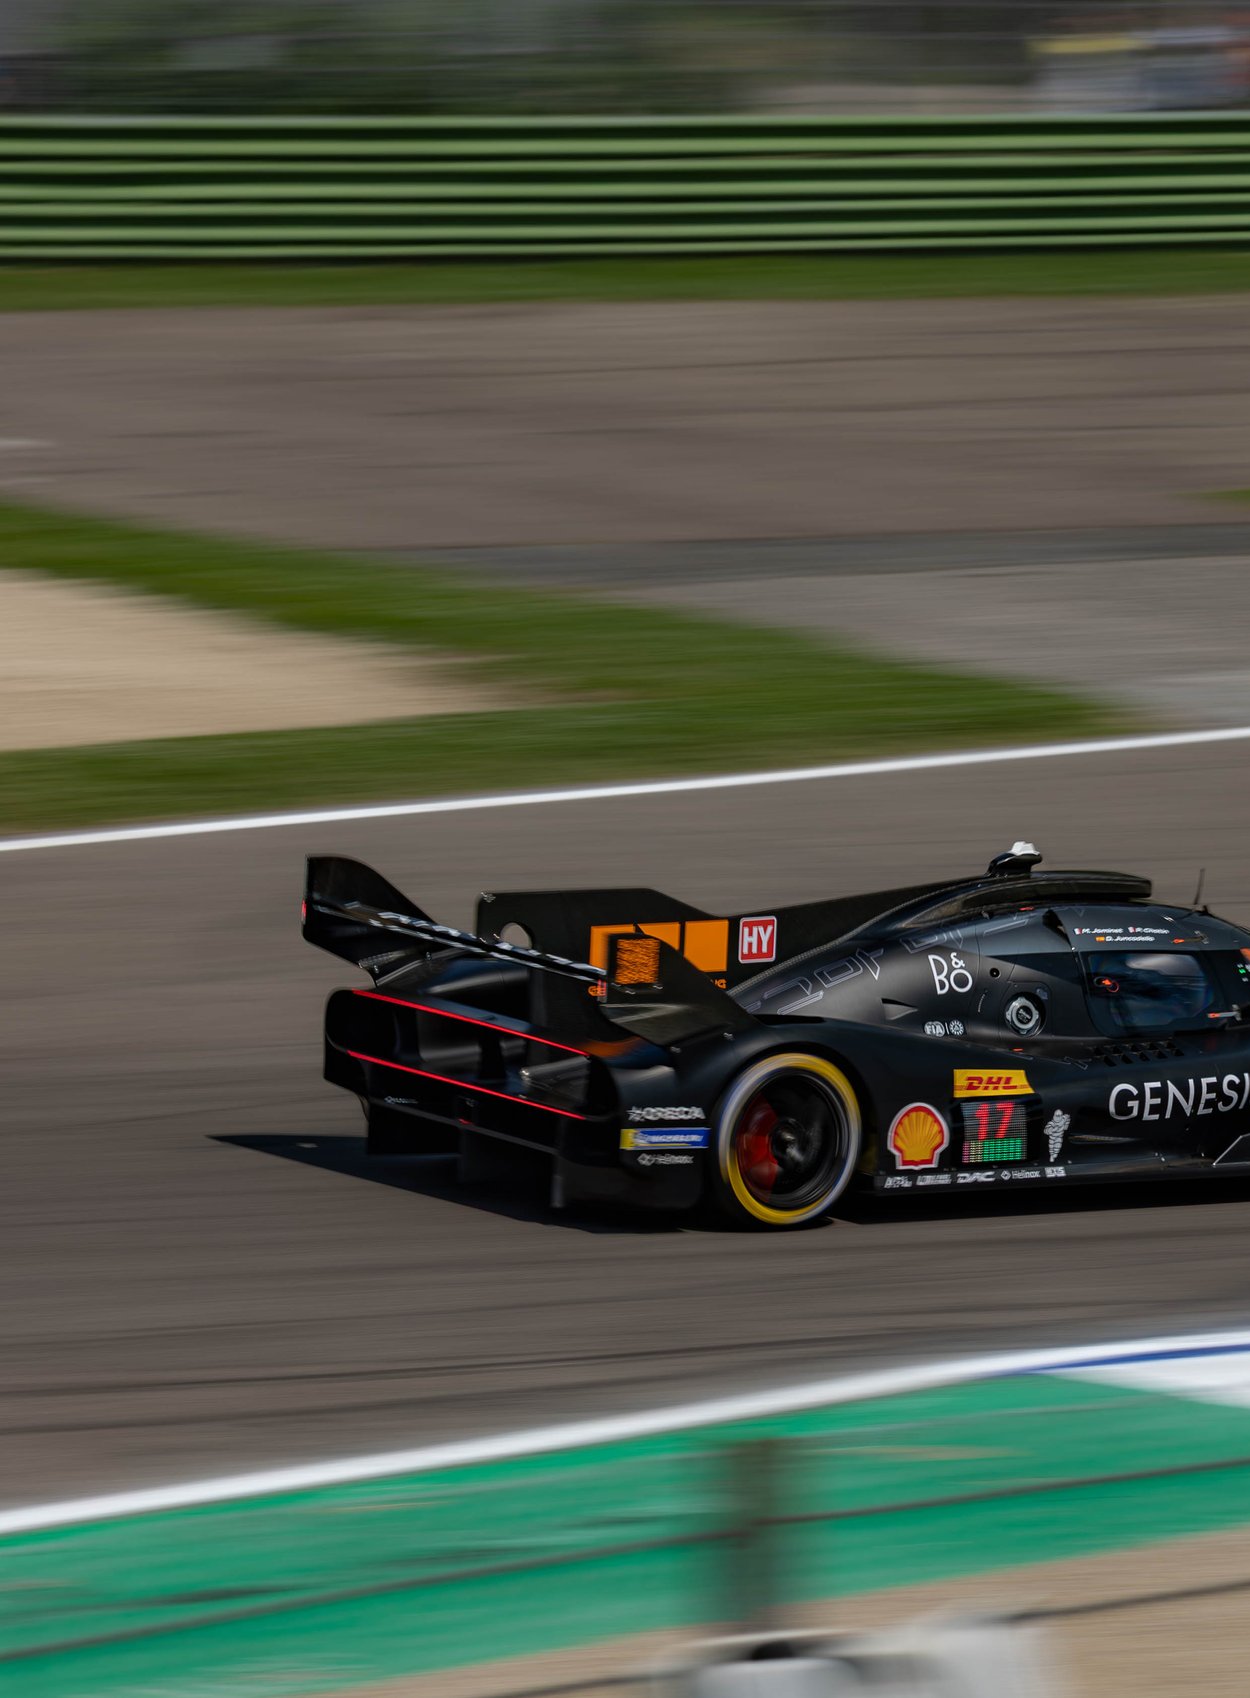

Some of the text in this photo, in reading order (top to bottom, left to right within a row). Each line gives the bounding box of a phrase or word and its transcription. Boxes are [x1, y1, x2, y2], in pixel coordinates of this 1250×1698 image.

[742, 926, 773, 954] HY
[925, 1021, 945, 1037] FIA
[964, 1076, 1018, 1091] DHL
[975, 1103, 1014, 1140] 17
